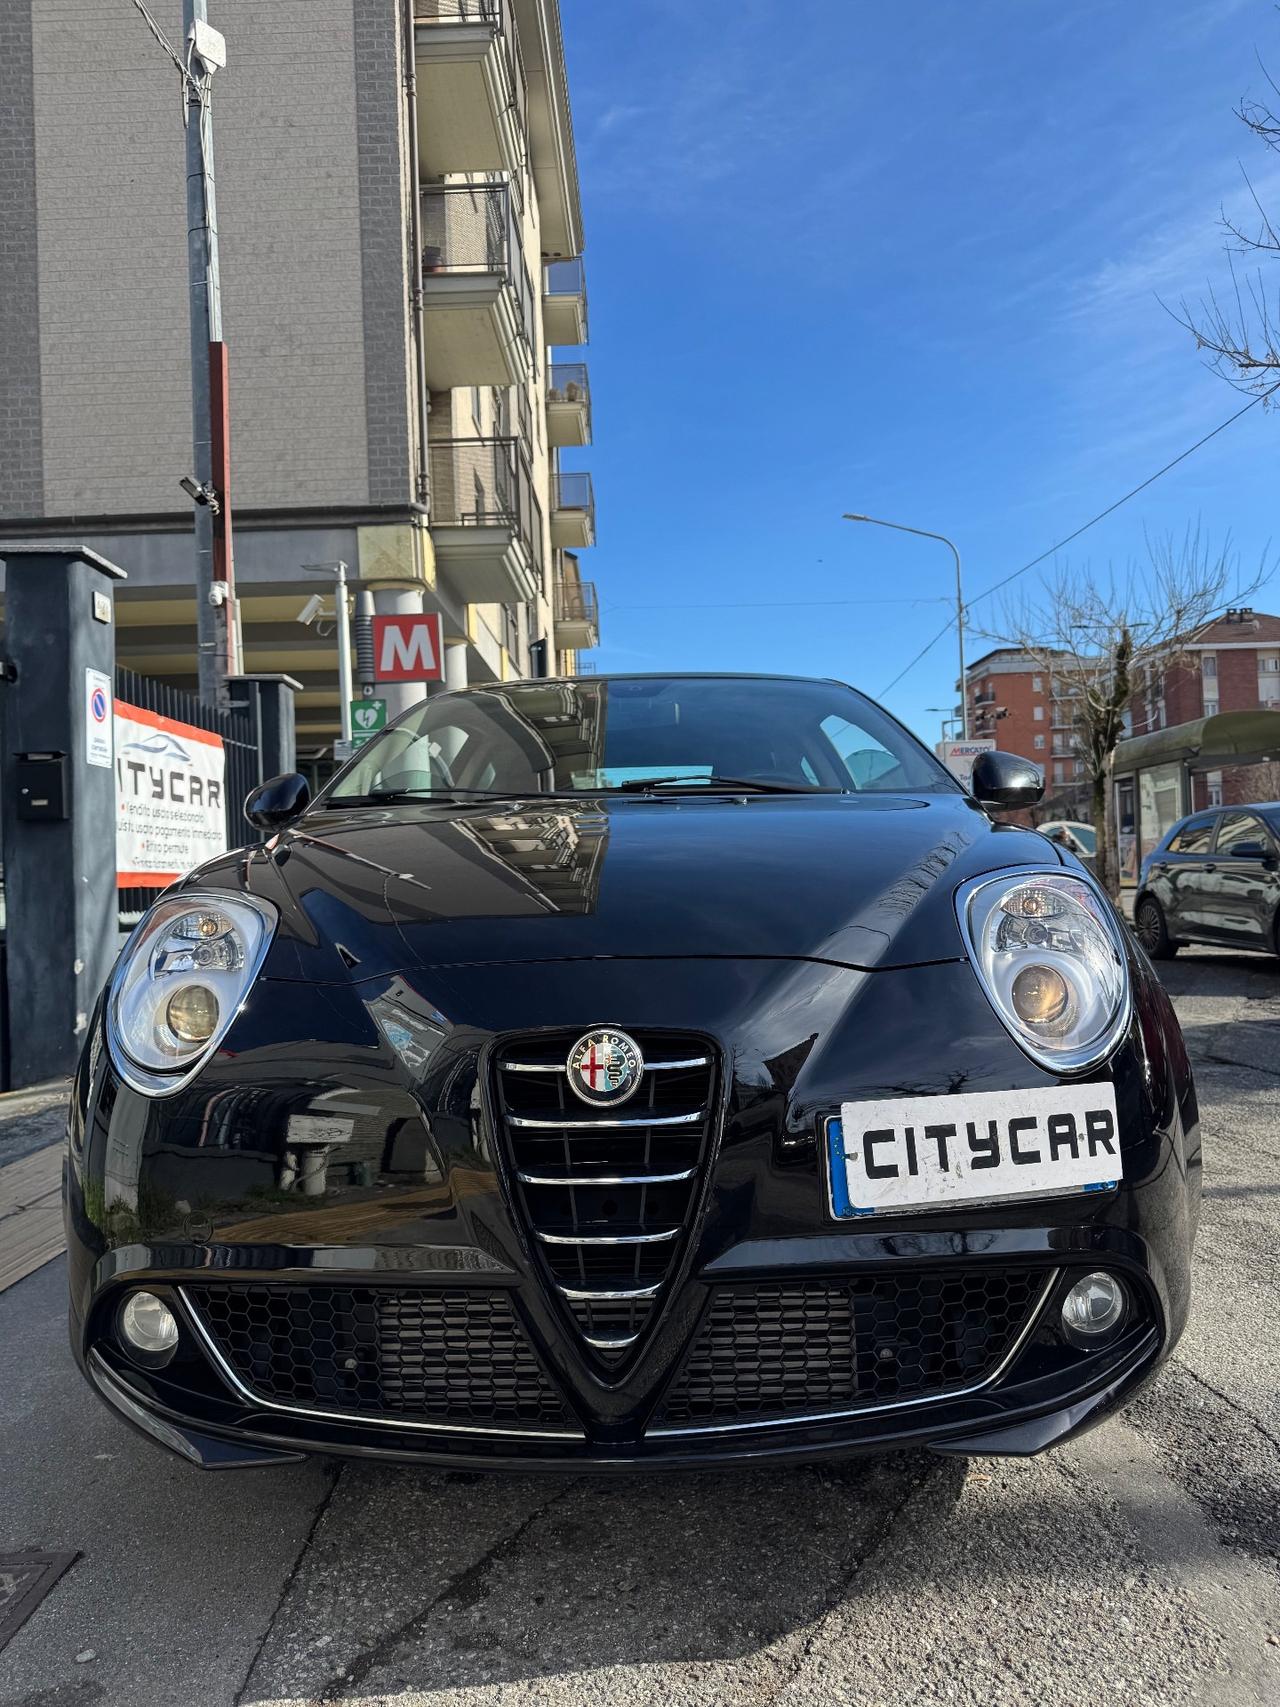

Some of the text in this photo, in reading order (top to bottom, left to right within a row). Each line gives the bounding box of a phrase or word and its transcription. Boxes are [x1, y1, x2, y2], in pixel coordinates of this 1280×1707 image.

[380, 624, 436, 671] M
[572, 1034, 637, 1070] ALFA ROMEO
[862, 1108, 1118, 1180] CITYCAR
